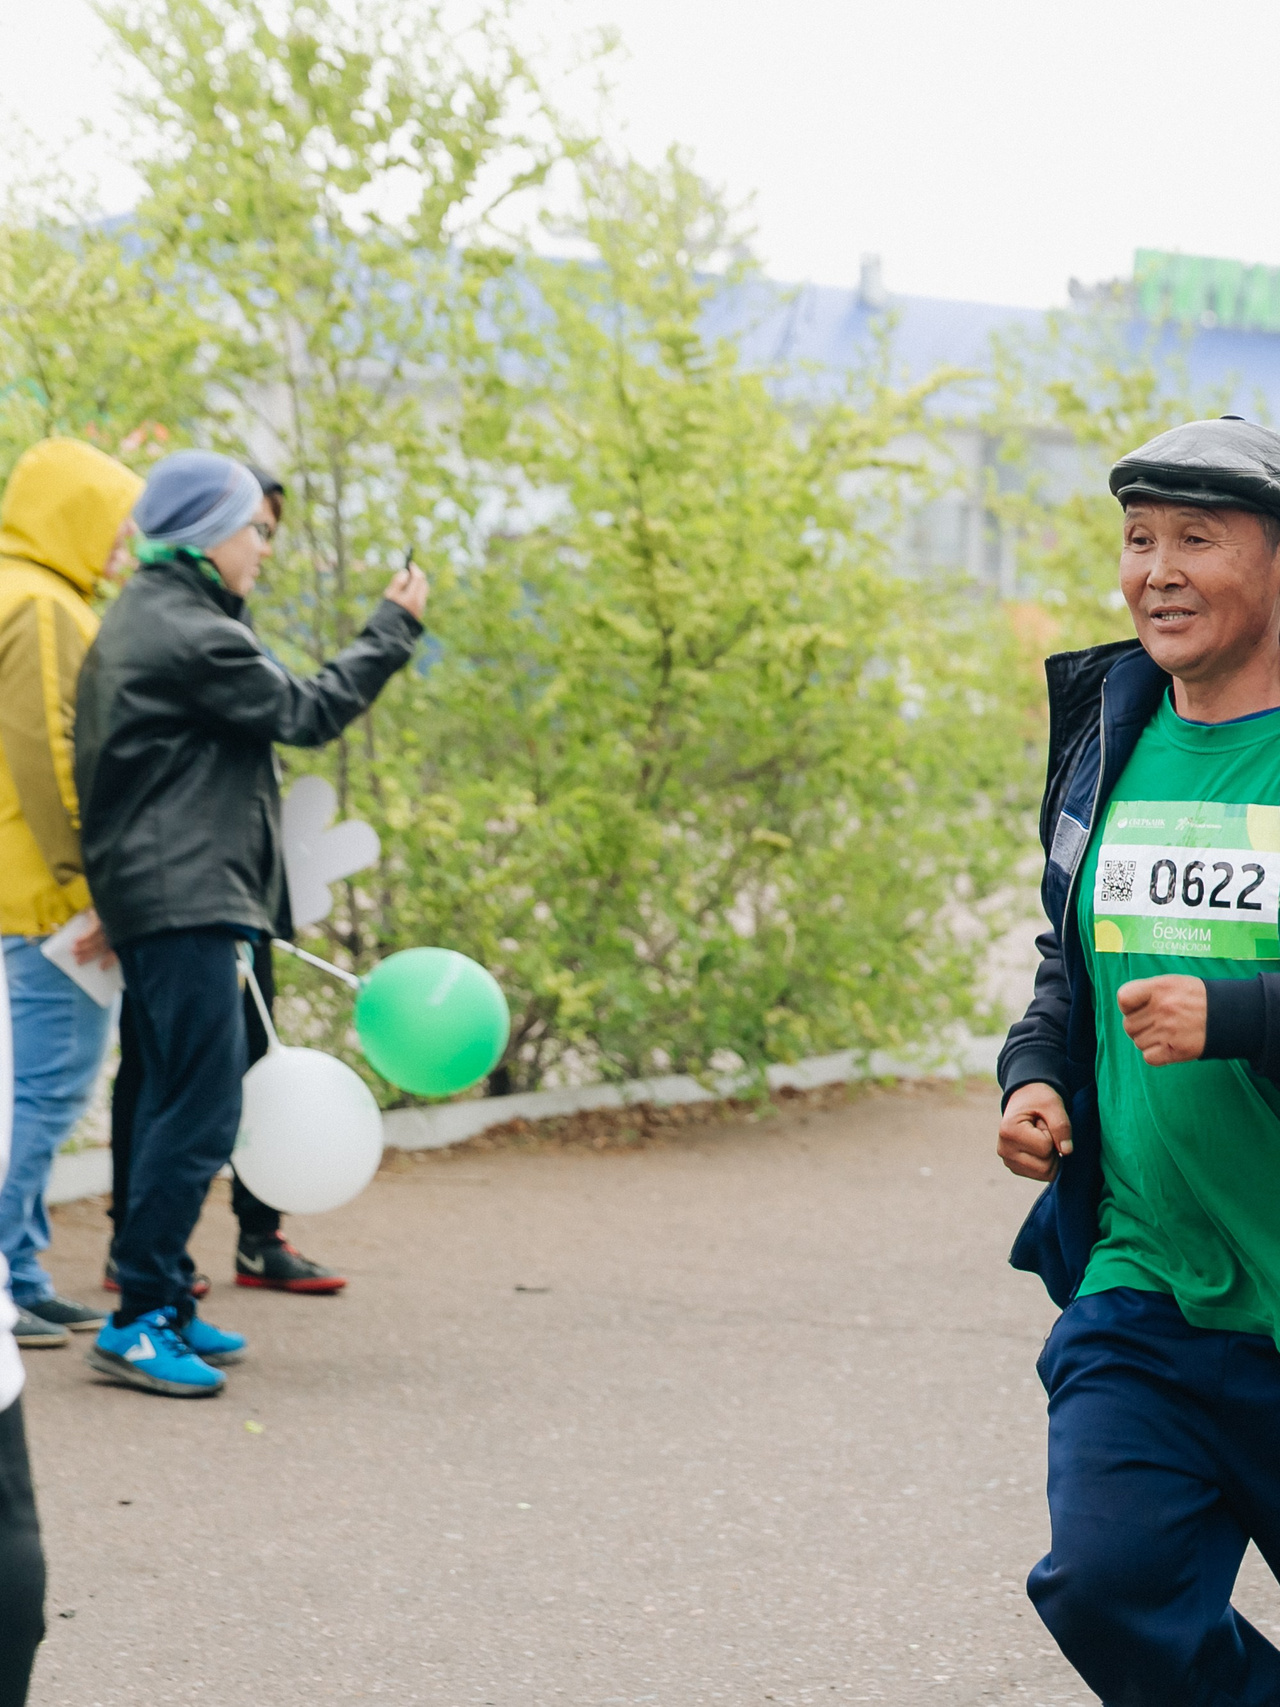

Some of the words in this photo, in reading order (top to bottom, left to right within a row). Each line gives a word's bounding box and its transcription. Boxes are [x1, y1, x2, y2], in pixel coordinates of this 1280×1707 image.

[1149, 858, 1265, 911] 0622
[1153, 921, 1211, 942] бежим
[1165, 941, 1211, 951] смыслом
